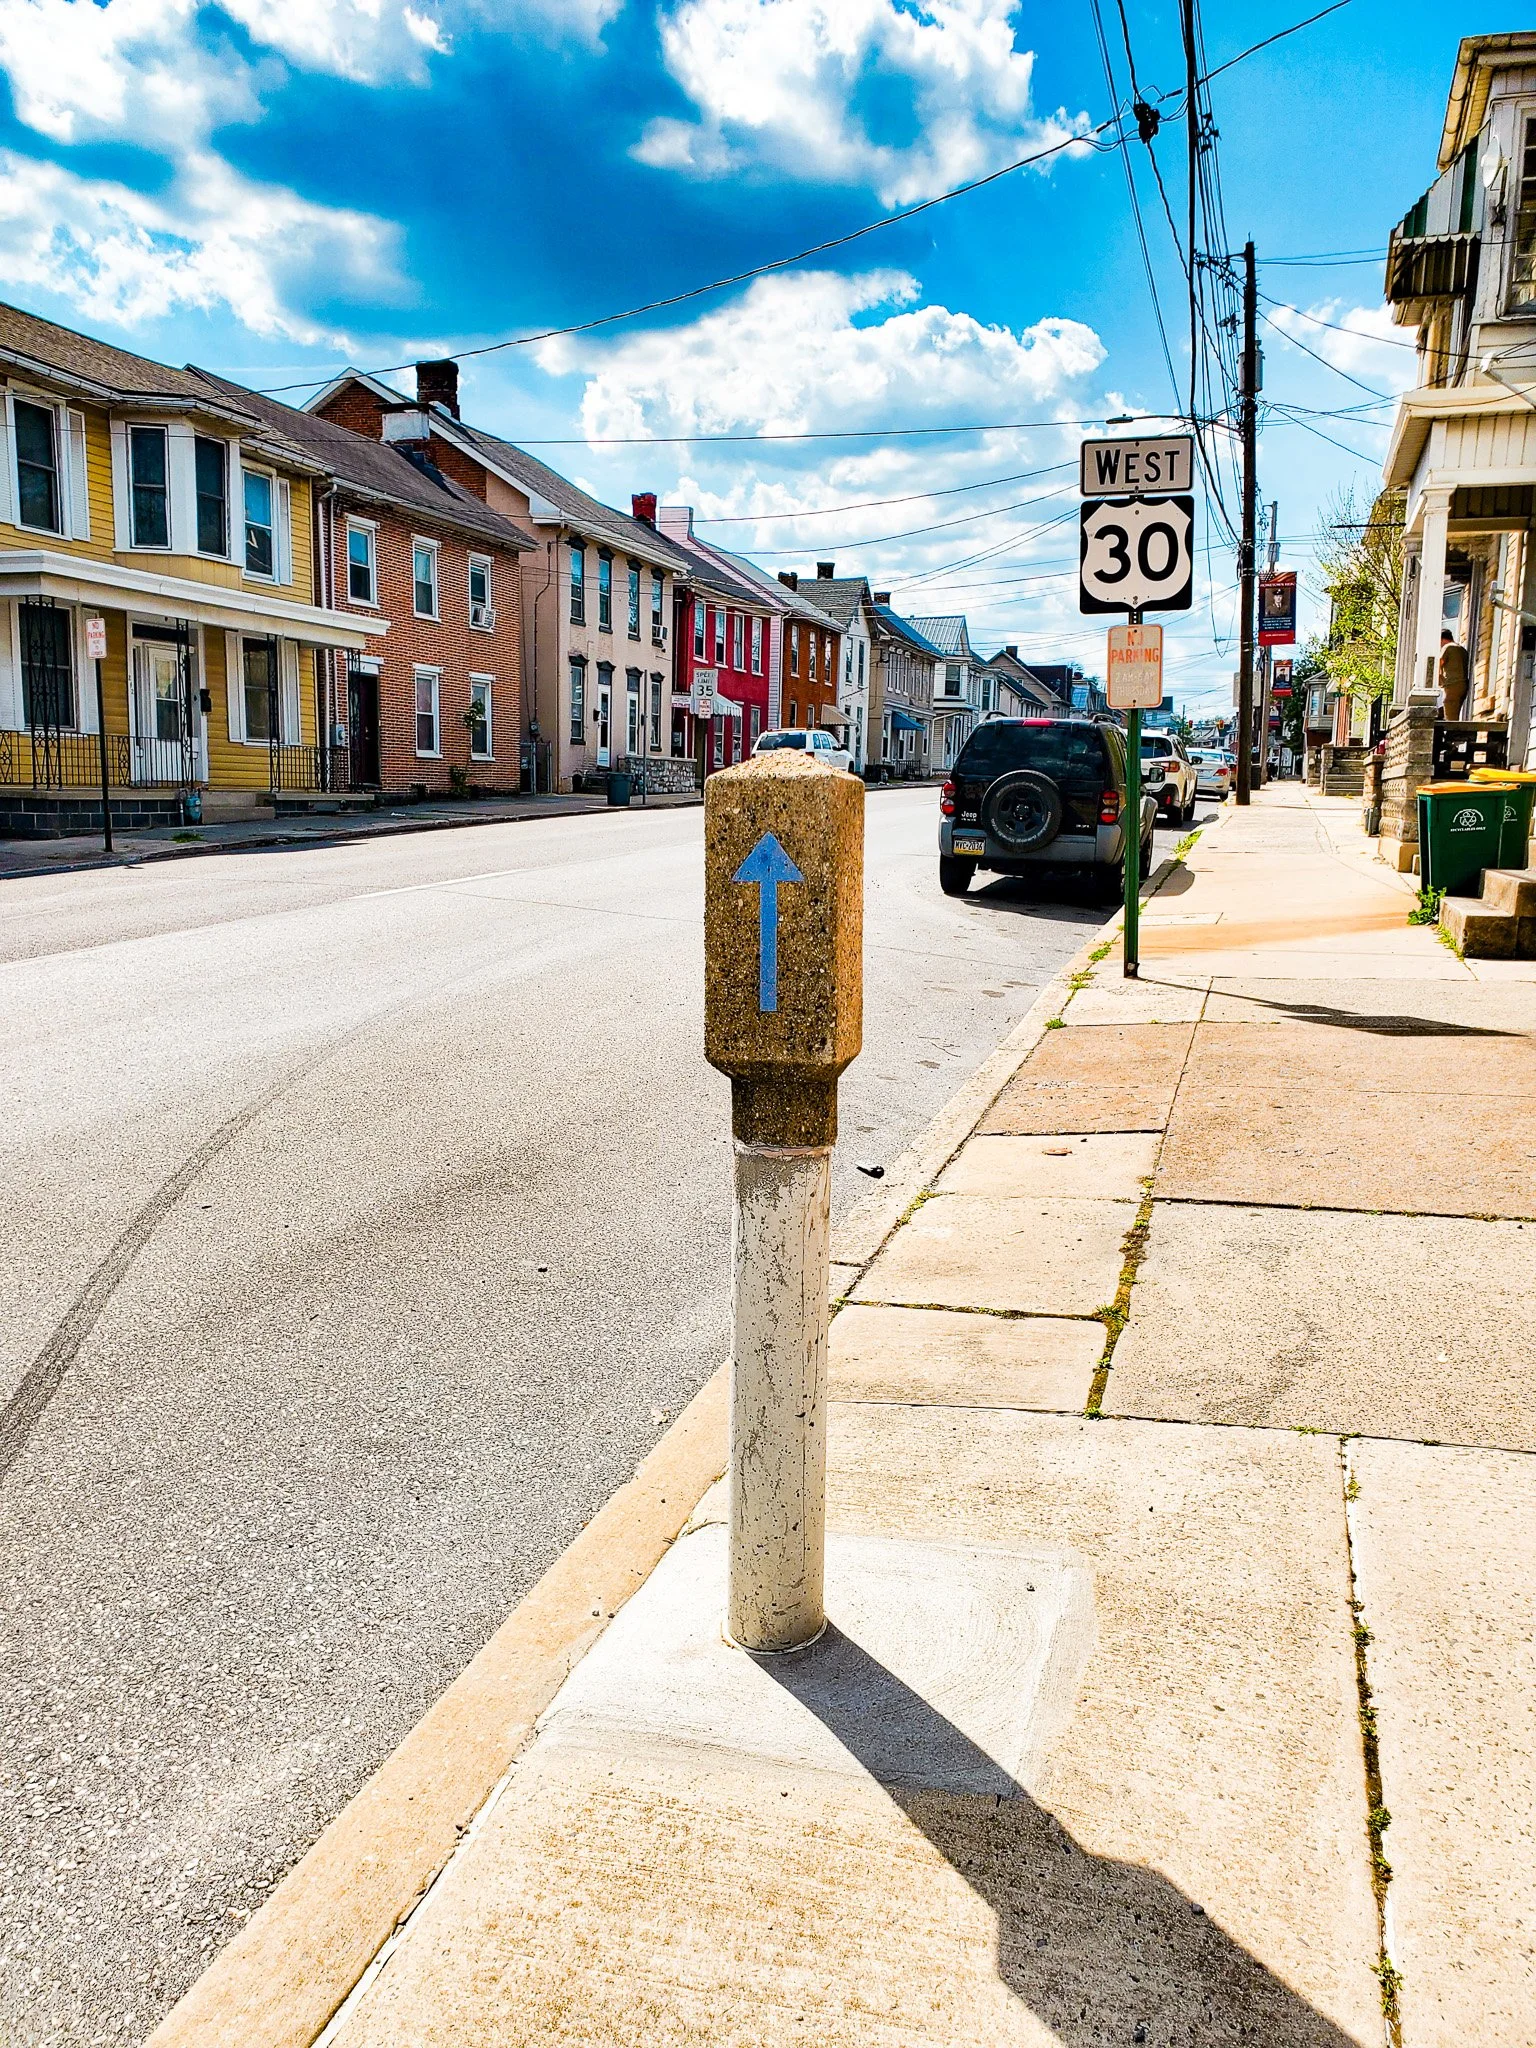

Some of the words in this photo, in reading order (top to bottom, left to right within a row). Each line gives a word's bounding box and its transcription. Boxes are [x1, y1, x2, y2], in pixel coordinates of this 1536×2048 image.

[1095, 449, 1180, 485] WEST
[1093, 521, 1179, 584] 30
[1111, 648, 1159, 664] PARKING
[696, 685, 714, 697] 35
[961, 811, 977, 819] Jeep
